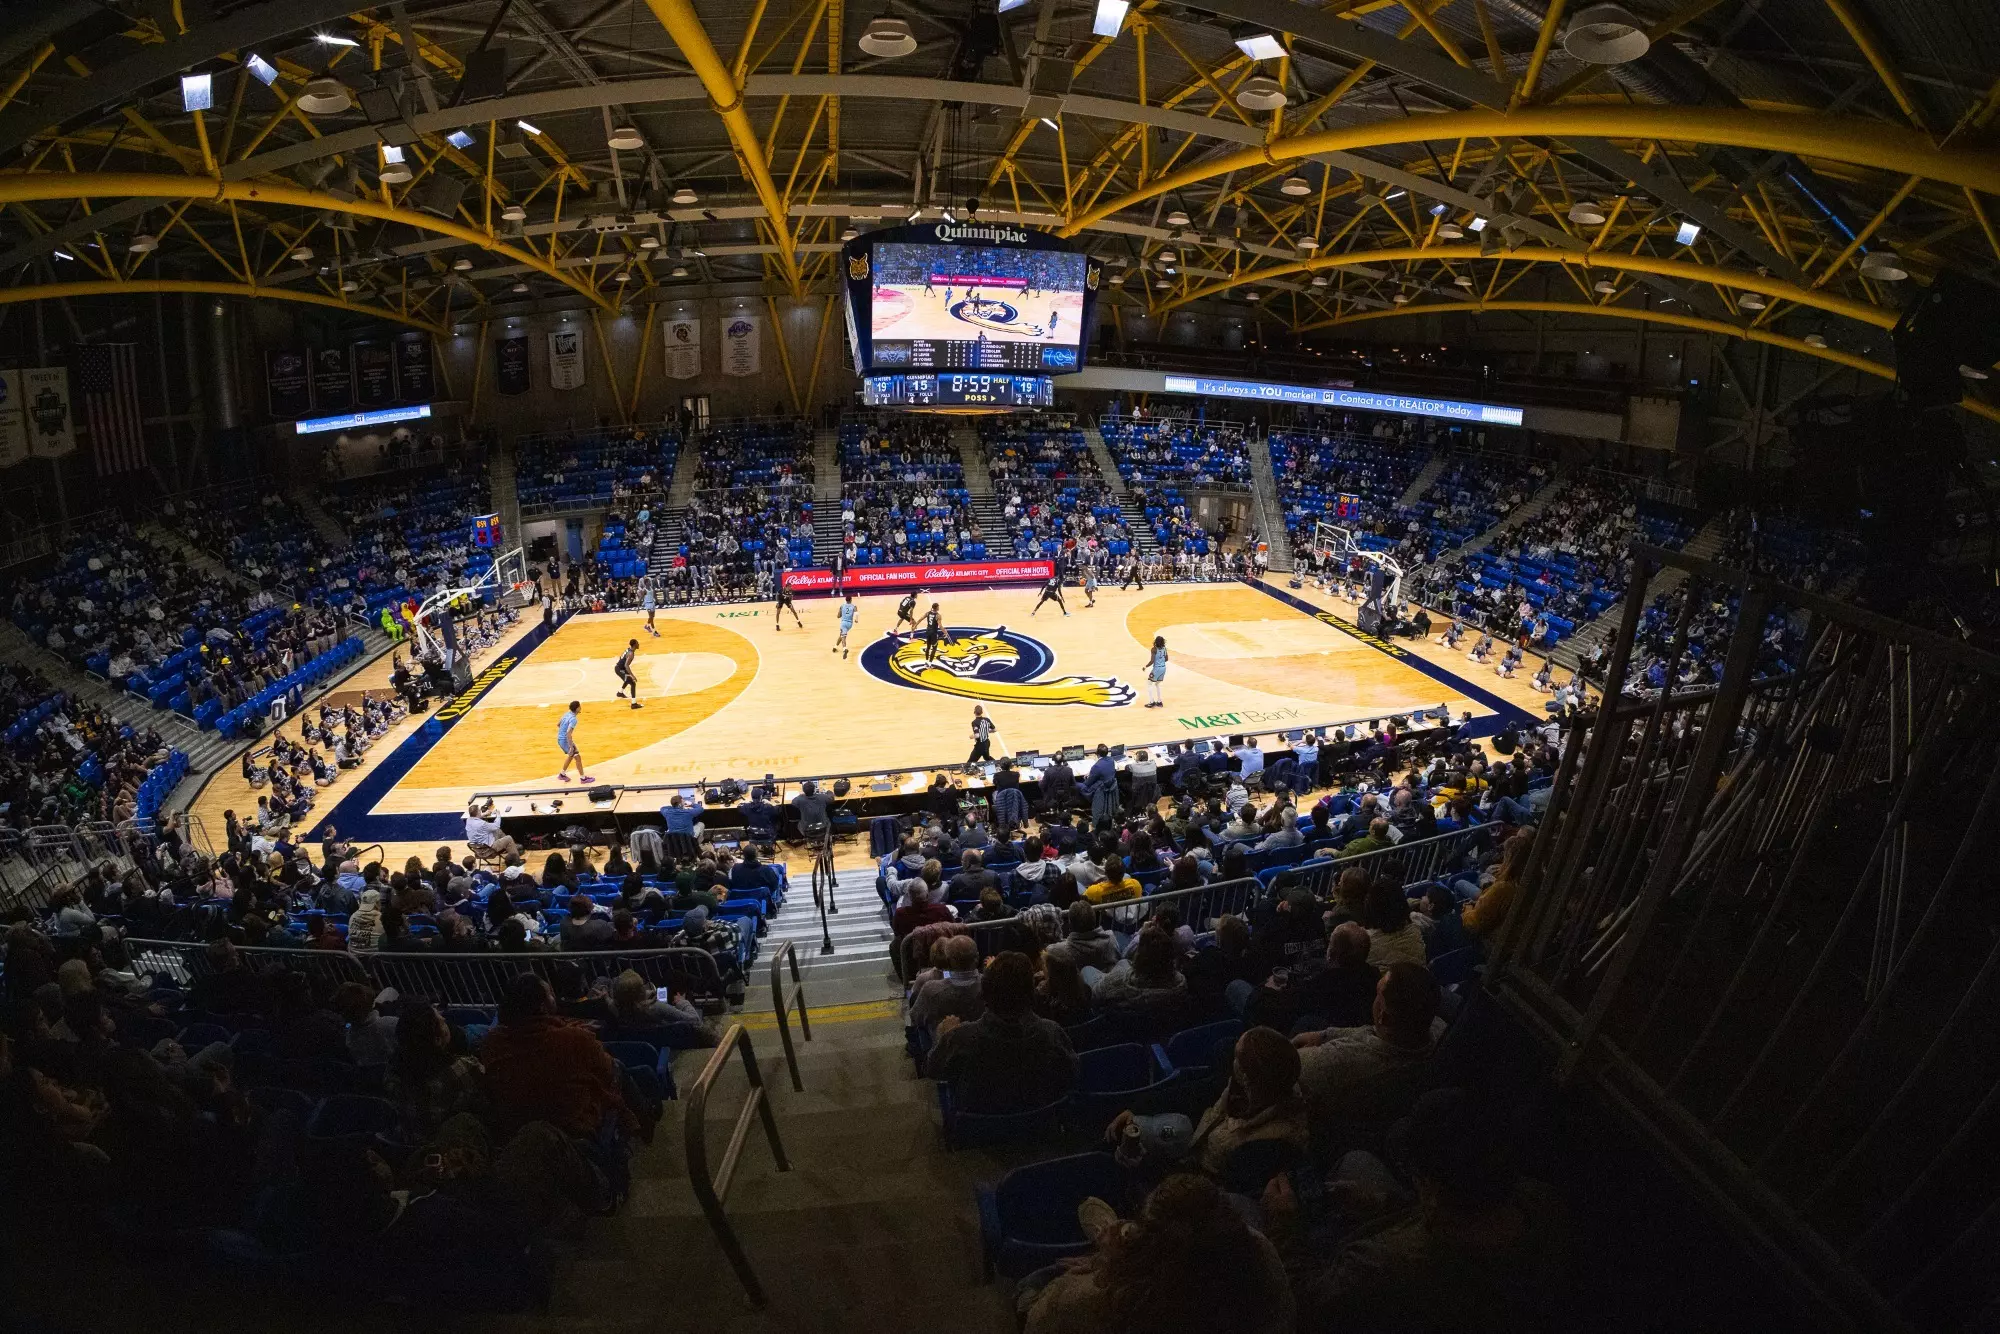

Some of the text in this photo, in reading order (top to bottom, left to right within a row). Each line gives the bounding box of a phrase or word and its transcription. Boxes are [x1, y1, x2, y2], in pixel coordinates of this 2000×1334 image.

[935, 223, 1028, 244] Quinnipiac
[877, 381, 887, 392] 19
[912, 380, 928, 391] 15
[952, 375, 990, 393] 8:59
[999, 385, 1005, 393] 1
[1020, 381, 1032, 393] 19
[1203, 382, 1216, 392] It's
[1218, 384, 1249, 396] always
[1259, 386, 1282, 397] YOU
[1284, 391, 1317, 400] market!
[1324, 392, 1334, 401] CT
[908, 396, 929, 404] 4 4
[964, 394, 987, 402] POSS
[1340, 393, 1374, 406] Contact
[1385, 397, 1397, 407] CT
[924, 567, 955, 579] Bally's
[995, 567, 1020, 575] OFFICIAL
[1032, 566, 1050, 574] HOTEL
[785, 574, 817, 586] Bally's
[859, 572, 917, 582] OFFICIAL FAN HOTEL
[1314, 612, 1408, 657] Quinnipiac
[434, 656, 518, 721] Quinnipiac
[1177, 707, 1301, 730] M&T Bank
